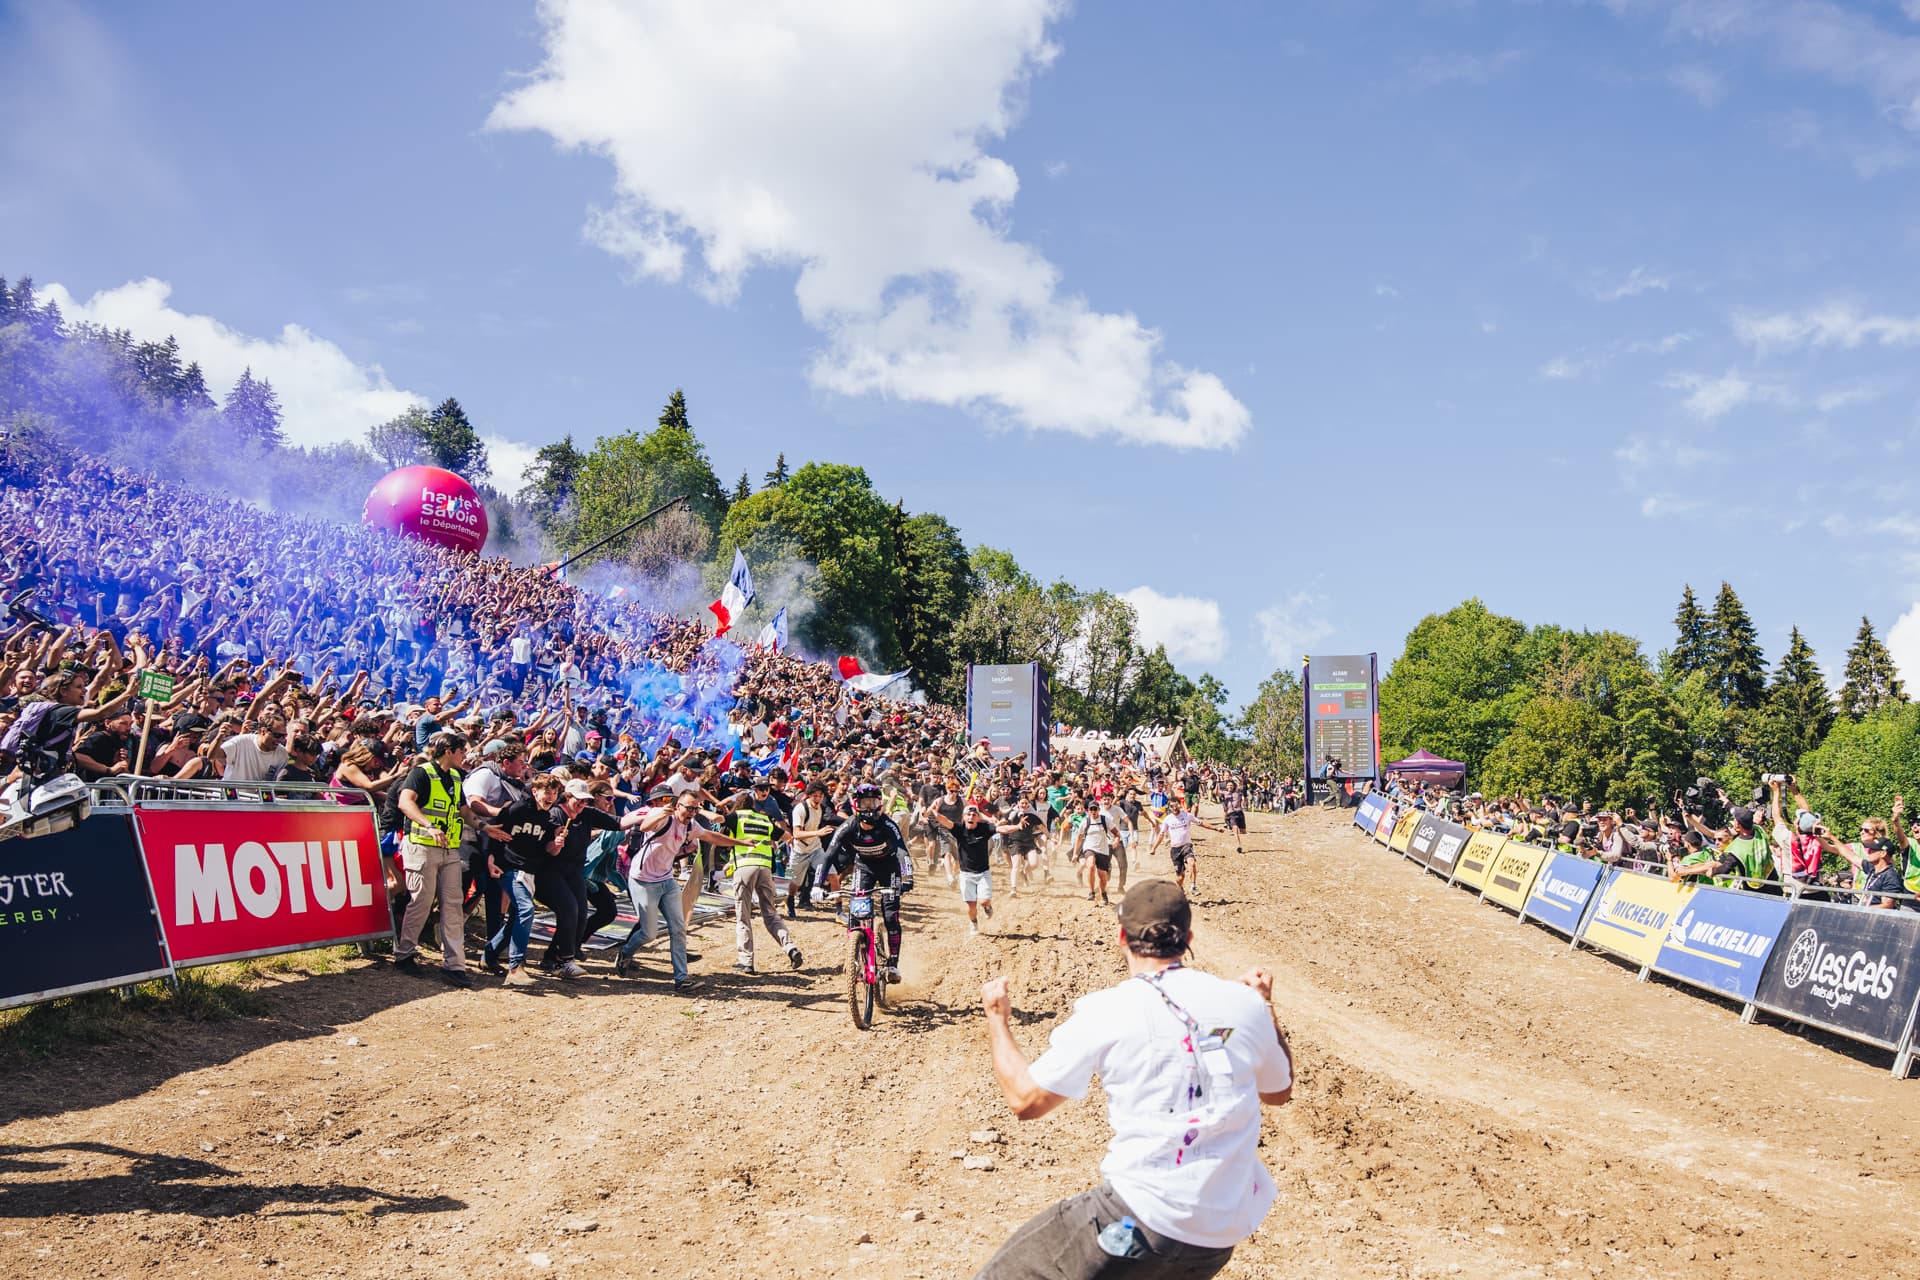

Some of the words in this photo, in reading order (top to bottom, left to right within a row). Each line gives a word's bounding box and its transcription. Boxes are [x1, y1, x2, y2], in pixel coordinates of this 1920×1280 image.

[420, 517, 430, 525] le
[1418, 824, 1436, 840] GoPro
[174, 840, 373, 927] MOTUL
[1546, 878, 1591, 905] MICHELIN
[1611, 900, 1670, 930] MICHELIN
[1688, 921, 1772, 959] MICHELIN
